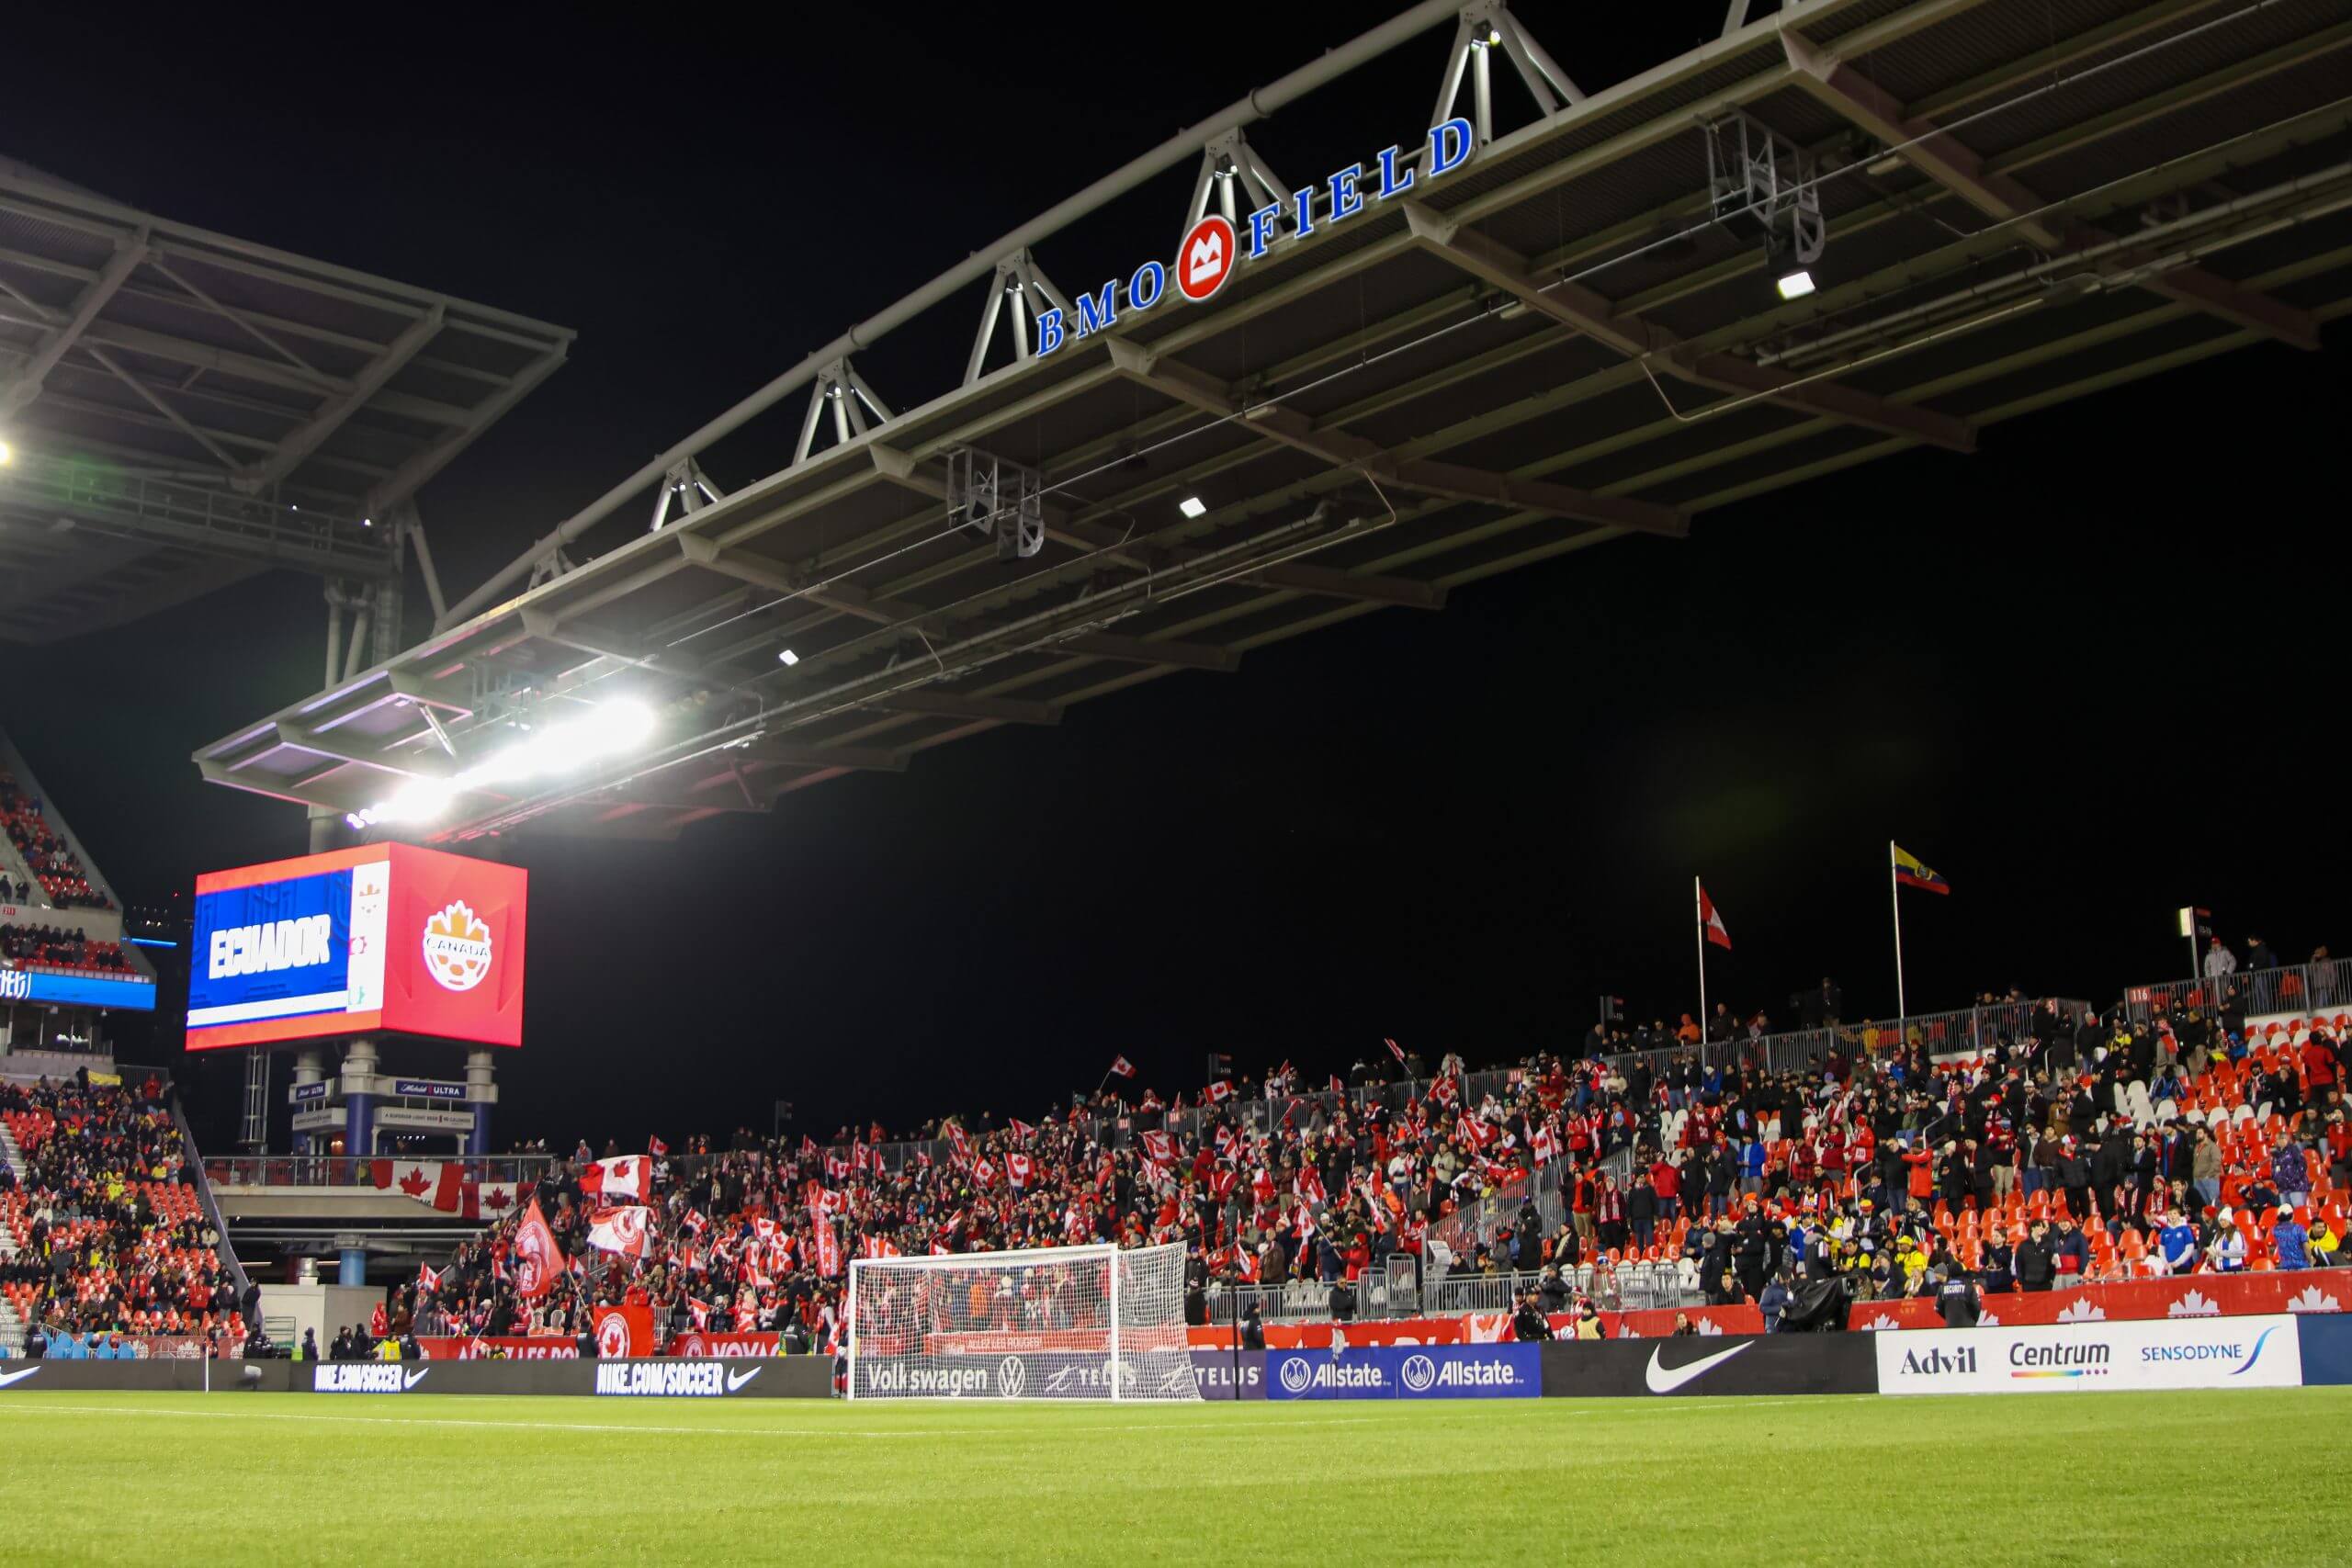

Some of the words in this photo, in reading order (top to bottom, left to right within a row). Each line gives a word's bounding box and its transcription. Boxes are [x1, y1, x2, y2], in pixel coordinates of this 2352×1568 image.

[1035, 259, 1166, 358] BMO
[1248, 116, 1475, 259] FIELD
[209, 913, 332, 980] ECUADOR
[425, 937, 492, 957] CANADA
[2132, 988, 2148, 1001] 116
[433, 1087, 459, 1097] ULTRA
[1943, 1284, 1966, 1294] SECURITY
[1900, 1346, 1977, 1375] Advil
[2009, 1341, 2109, 1367] Centrum
[2141, 1343, 2243, 1362] SENSODYNE
[314, 1364, 402, 1393] NIKE.COM/SOCCER
[596, 1362, 724, 1395] NIKE.COM/SOCCER
[867, 1362, 988, 1396] Volkswagen
[1195, 1366, 1260, 1386] TELUS
[1311, 1362, 1383, 1388] Allstate
[1436, 1359, 1514, 1386] Allstate
